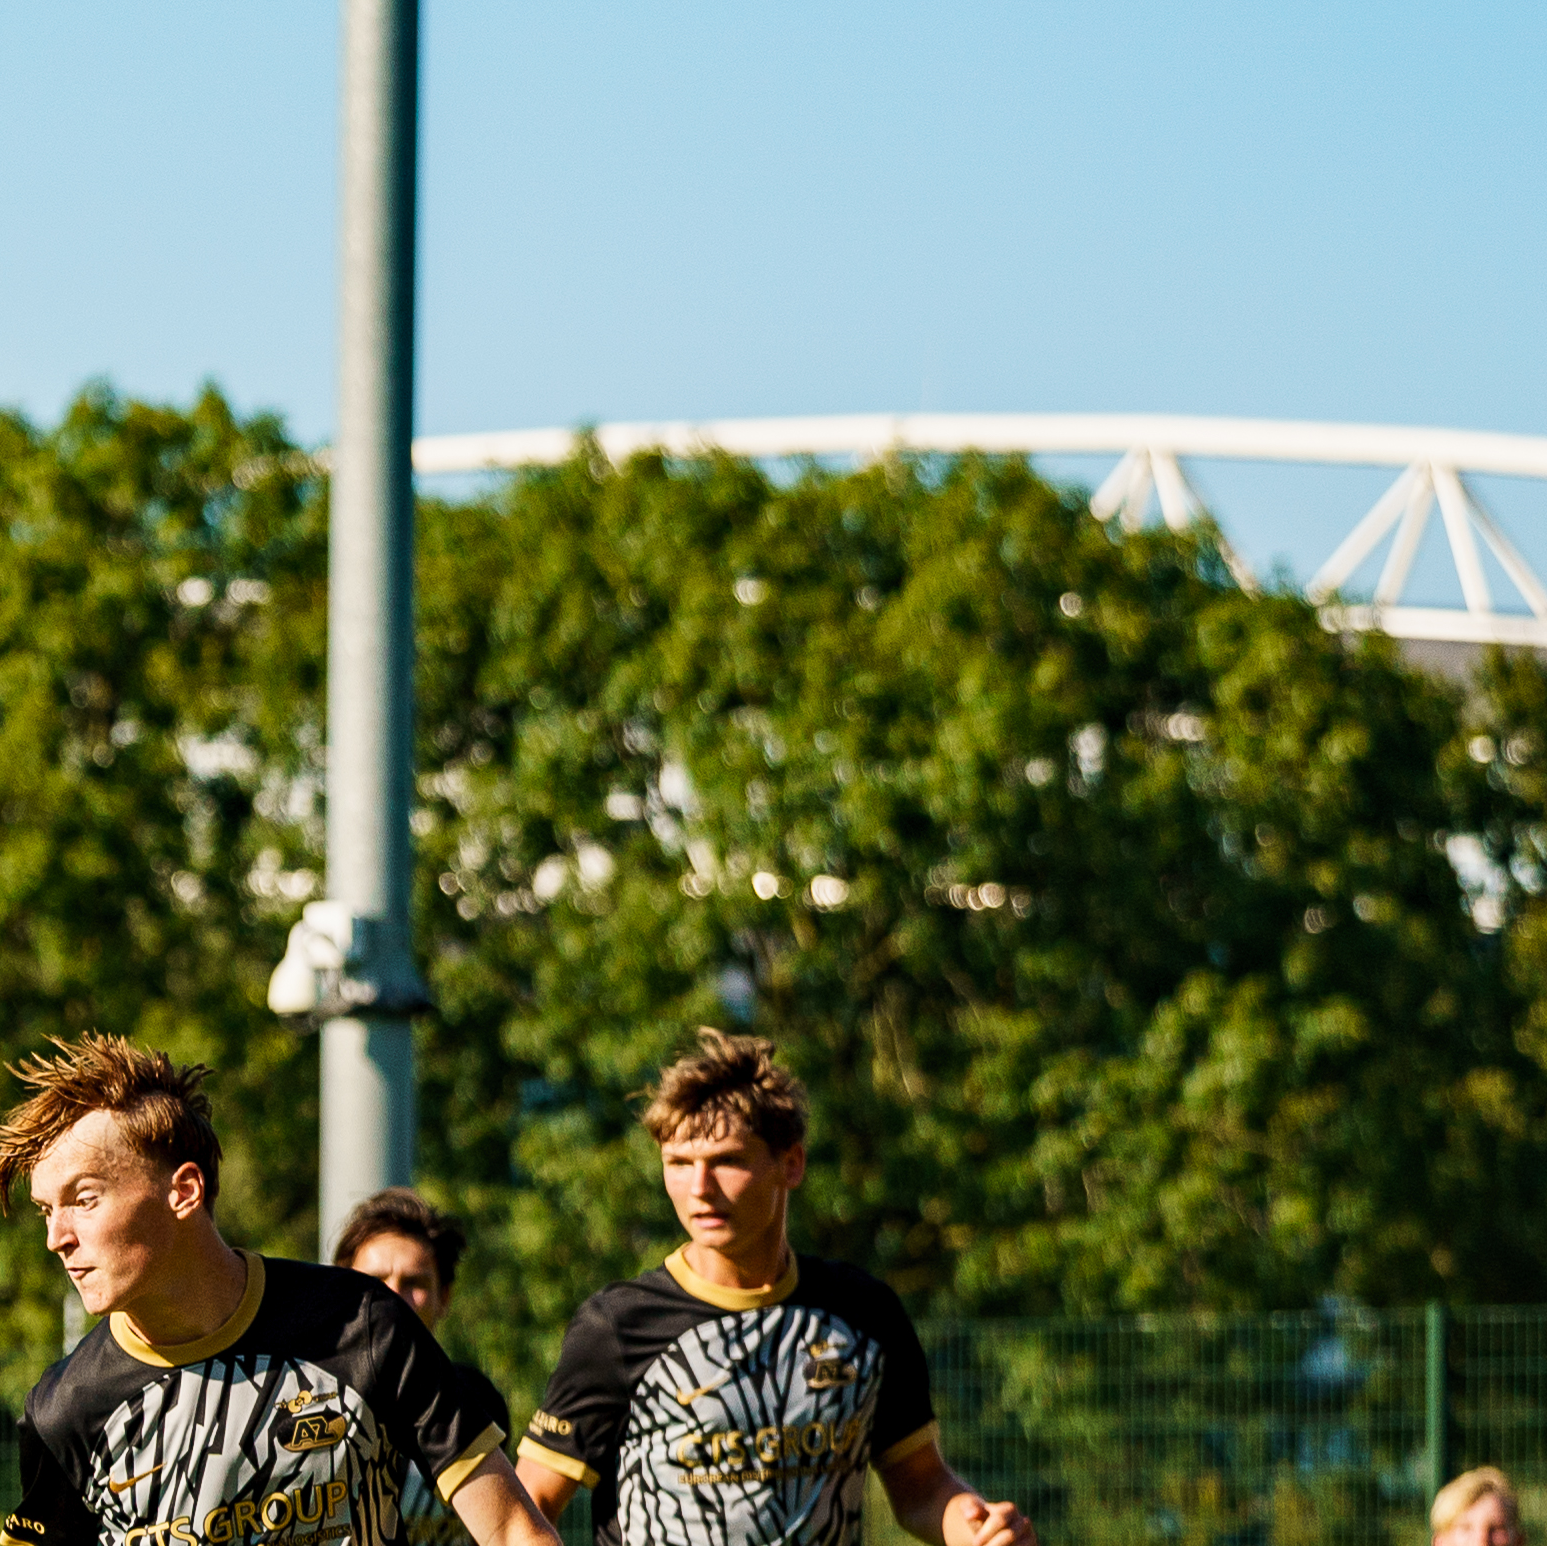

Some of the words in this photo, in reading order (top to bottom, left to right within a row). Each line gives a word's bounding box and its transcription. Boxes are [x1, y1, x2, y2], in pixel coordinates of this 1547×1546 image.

[291, 1415, 339, 1447] AZ
[676, 1430, 746, 1469] CTS
[202, 1479, 349, 1544] GROUP
